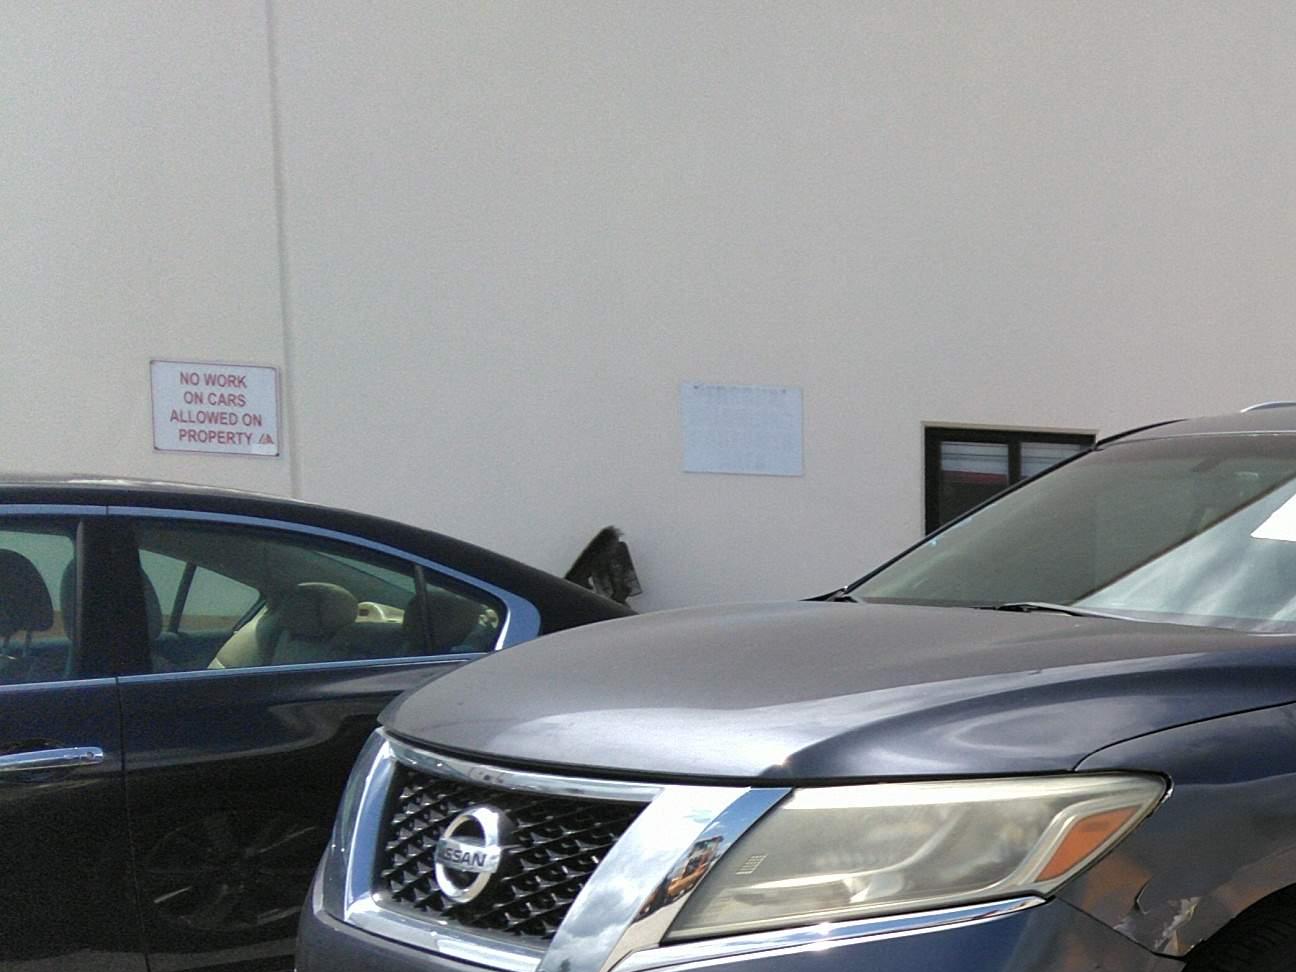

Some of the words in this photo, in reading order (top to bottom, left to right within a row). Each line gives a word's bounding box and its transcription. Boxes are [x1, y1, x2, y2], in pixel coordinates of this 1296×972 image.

[179, 371, 200, 386] NO
[203, 373, 248, 389] WORK
[183, 391, 204, 405] ON
[207, 392, 247, 407] CARS
[169, 409, 239, 426] ALLOWED
[241, 413, 263, 427] ON
[178, 428, 254, 445] PROPERTY
